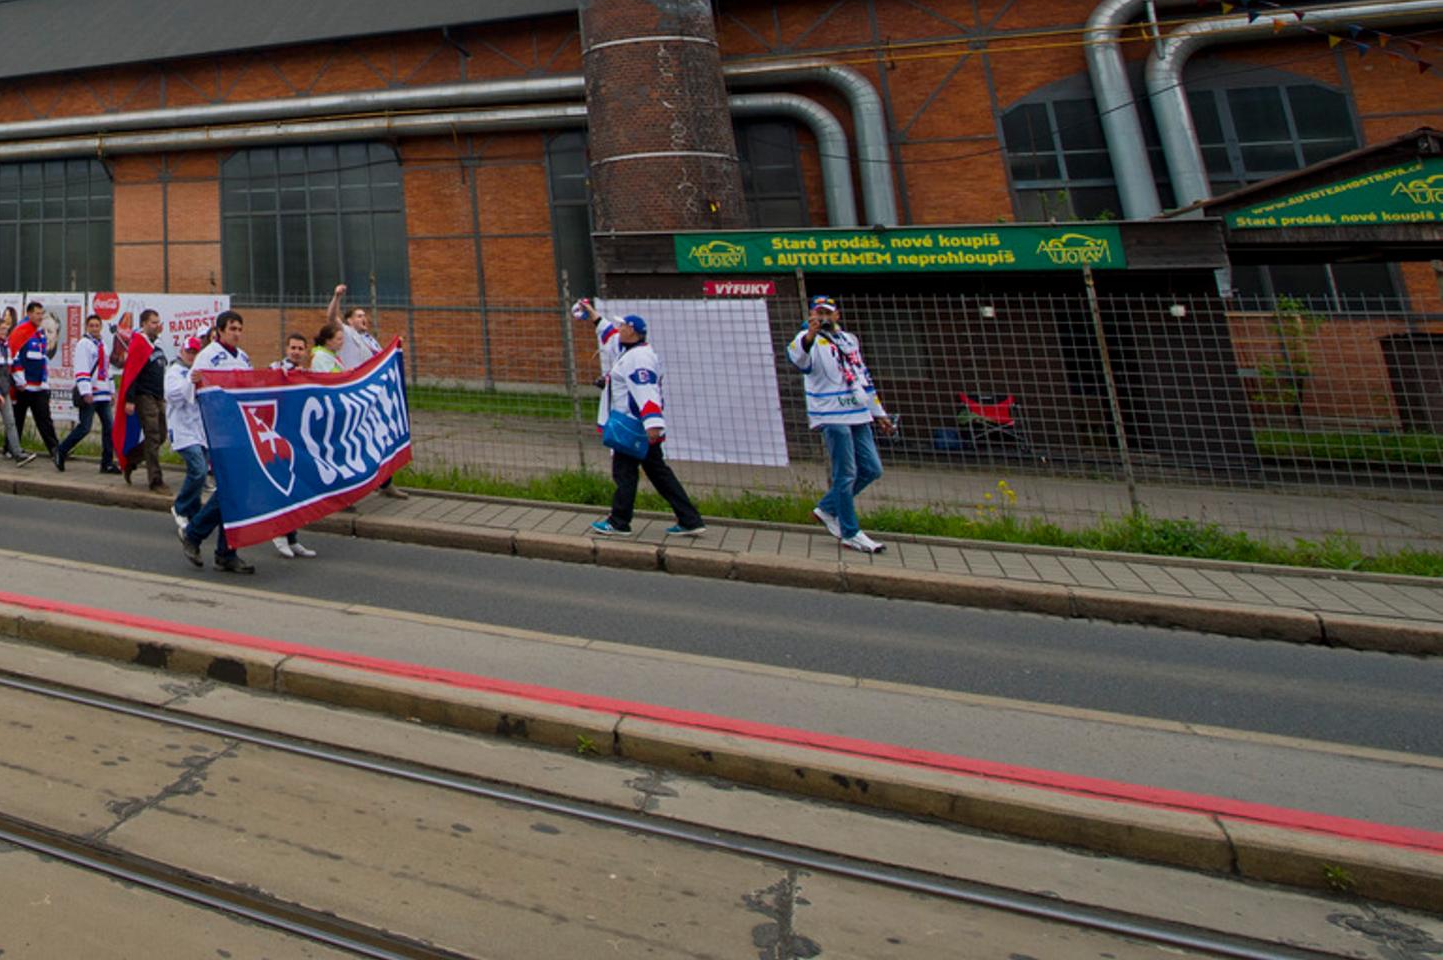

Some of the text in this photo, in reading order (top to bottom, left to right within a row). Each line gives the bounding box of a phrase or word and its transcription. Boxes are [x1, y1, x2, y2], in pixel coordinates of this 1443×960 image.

[1235, 213, 1276, 227] Staré
[1341, 211, 1378, 223] nové
[1382, 209, 1435, 224] koupíš
[771, 233, 1000, 251] Staré prodáš, nové koupíš
[763, 249, 1016, 268] s AUTOTEAMEM neprohloupíš
[715, 281, 770, 295] VÝFUKY
